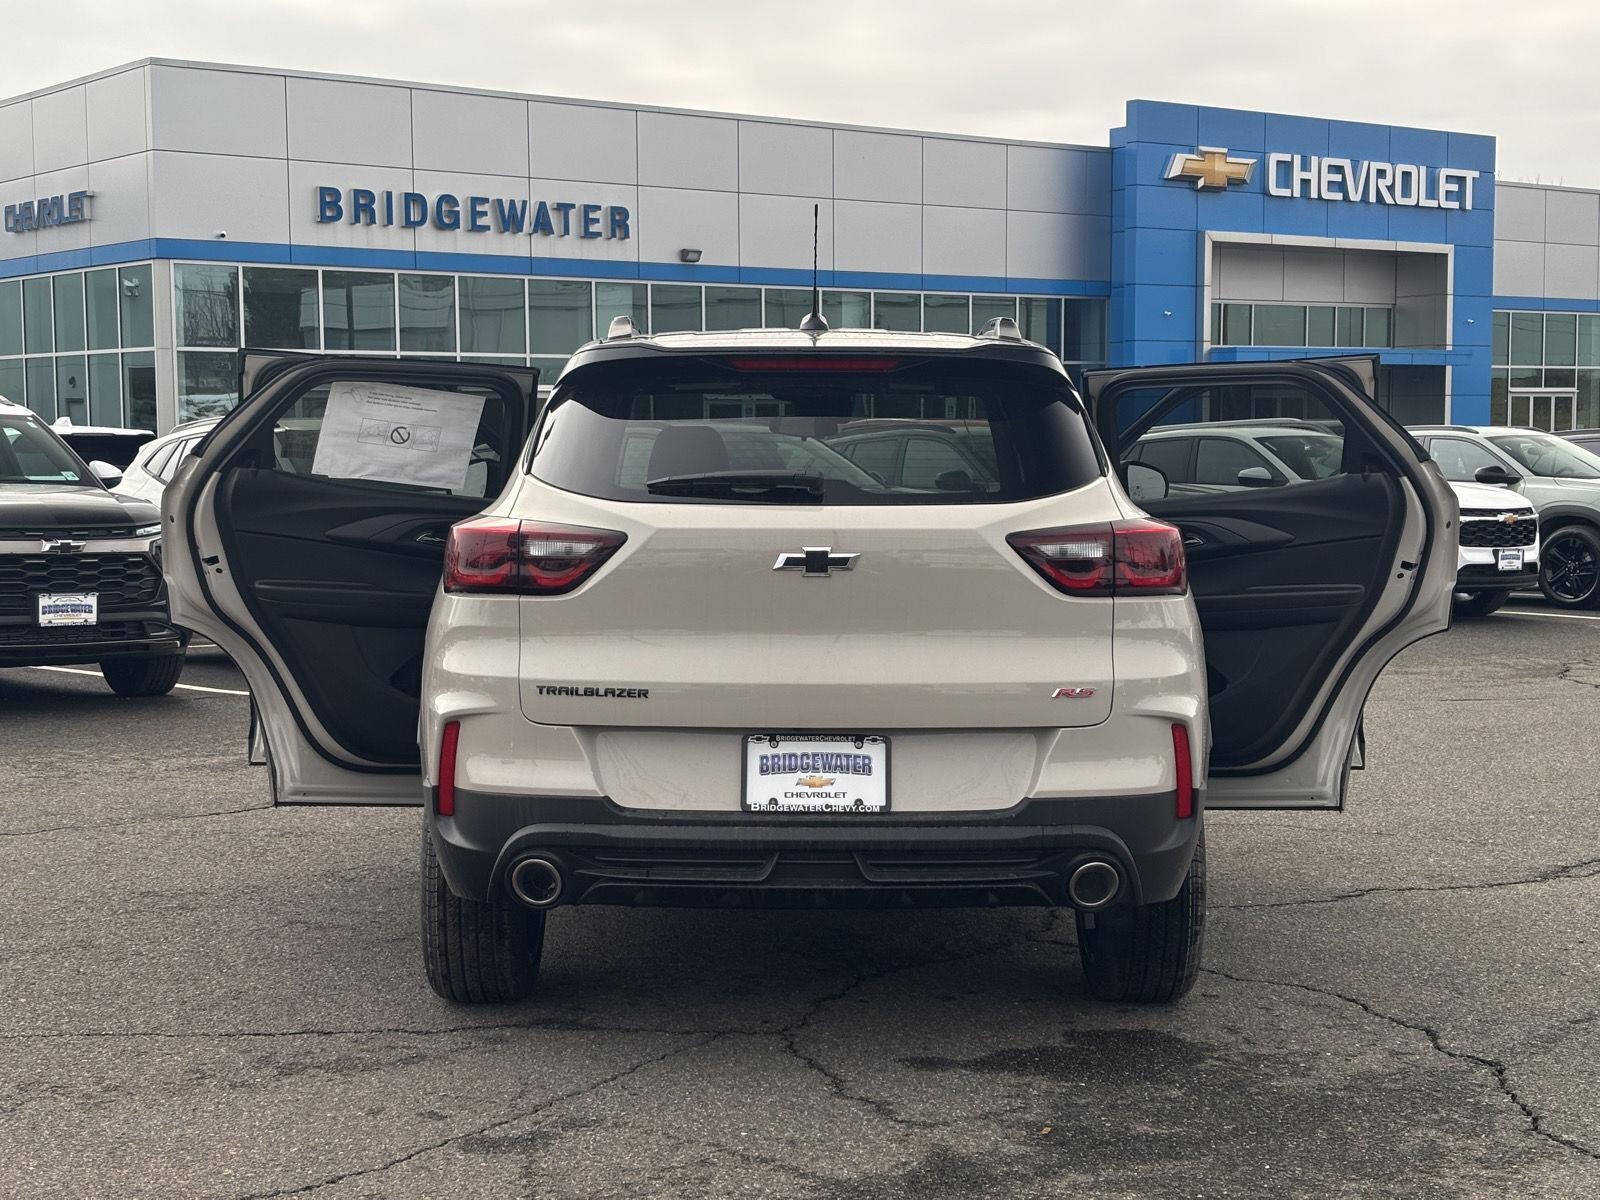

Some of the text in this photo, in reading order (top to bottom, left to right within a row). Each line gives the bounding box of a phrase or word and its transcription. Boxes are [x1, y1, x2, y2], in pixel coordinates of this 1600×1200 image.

[1265, 151, 1480, 211] CHEVROLET
[5, 190, 94, 233] CHEVROLET
[316, 186, 631, 240] BRIDGEWATER
[536, 685, 649, 699] TRAILBLAZER
[1051, 687, 1096, 699] RS
[758, 751, 873, 776] BRIDGEWATER
[784, 791, 847, 799] CHEVROLET
